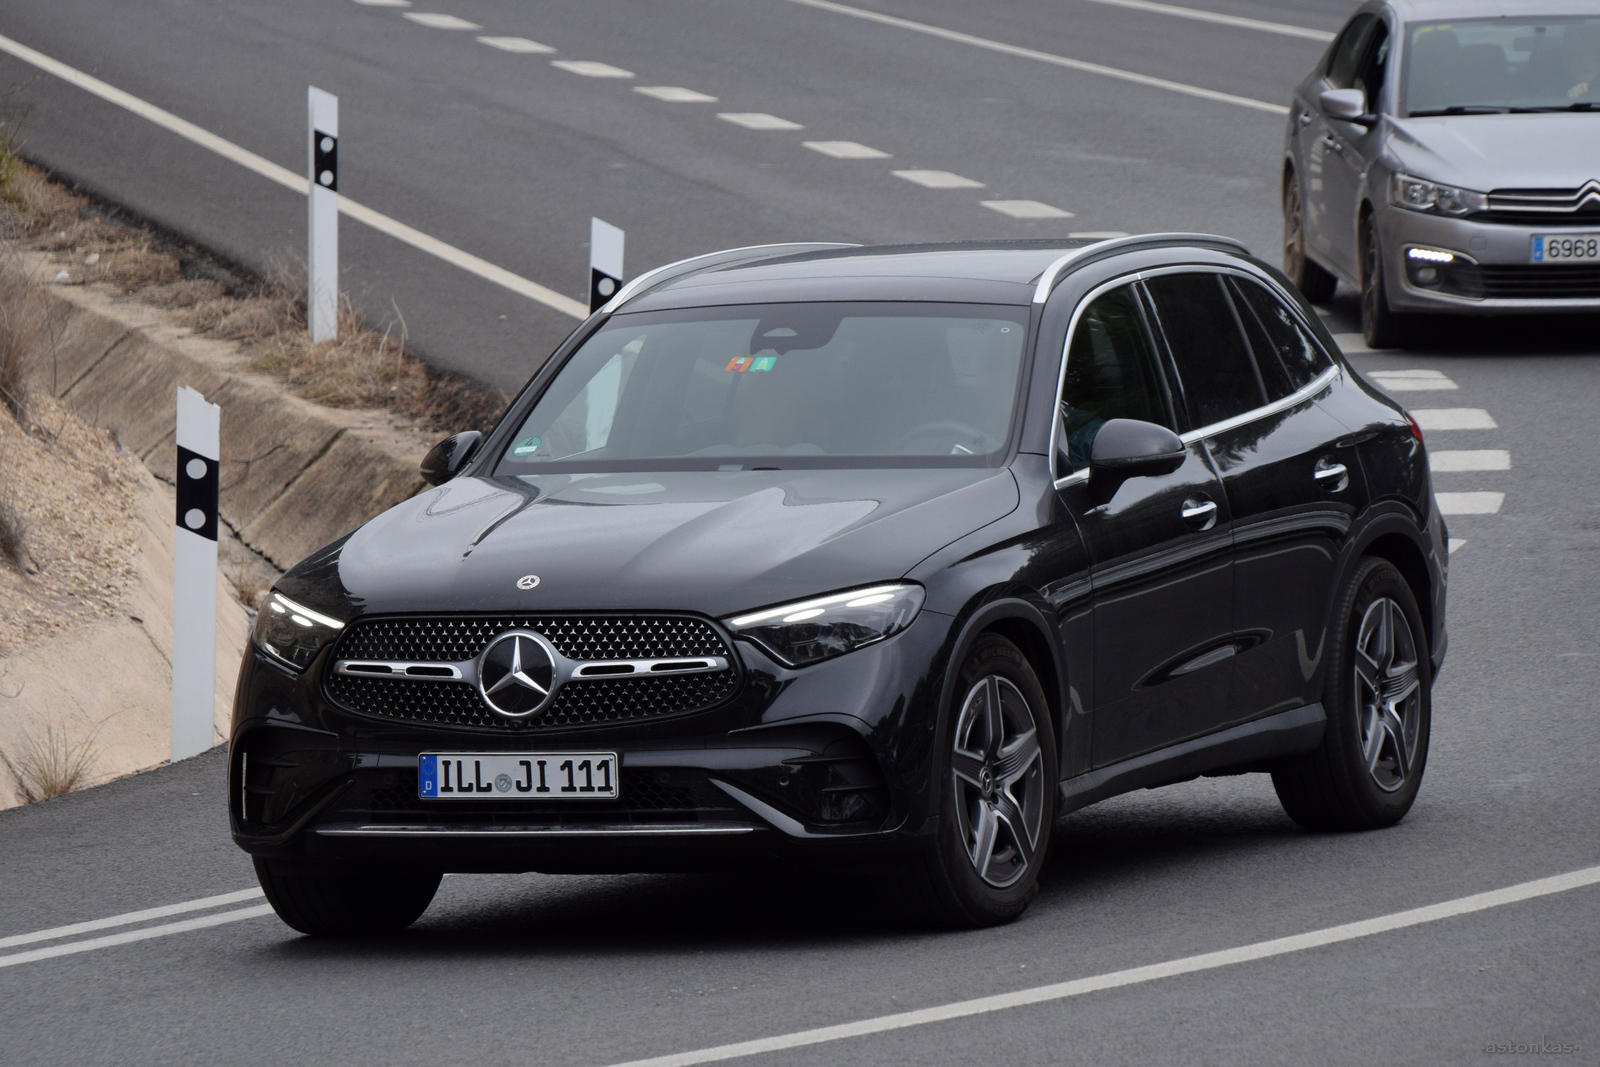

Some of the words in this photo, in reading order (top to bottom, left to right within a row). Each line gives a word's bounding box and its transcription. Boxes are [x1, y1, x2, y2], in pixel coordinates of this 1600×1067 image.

[1549, 239, 1598, 258] 6968
[425, 780, 432, 790] D
[440, 760, 492, 792] ILL
[515, 760, 550, 792] JI
[560, 760, 614, 792] 111
